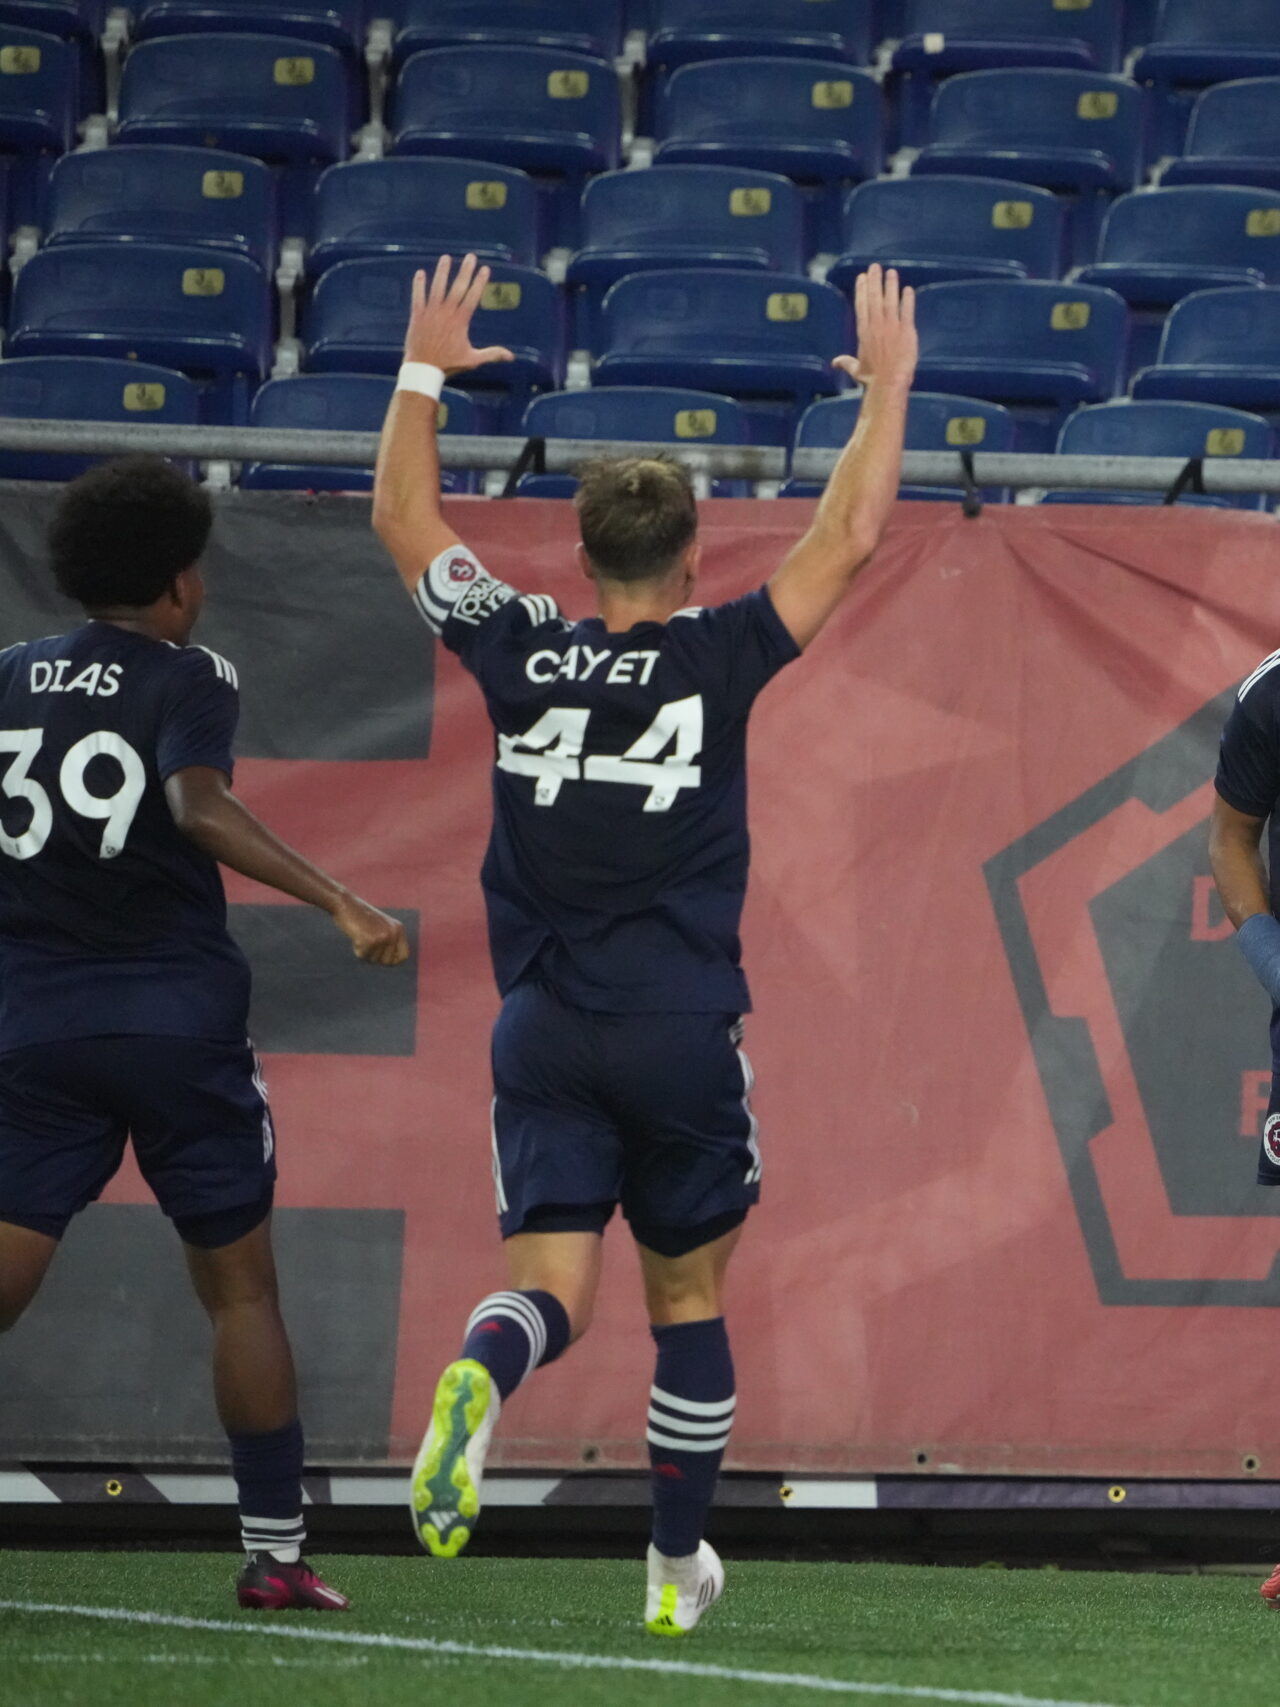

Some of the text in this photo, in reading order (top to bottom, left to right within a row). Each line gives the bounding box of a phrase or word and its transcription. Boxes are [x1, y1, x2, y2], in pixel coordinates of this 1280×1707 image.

[30, 659, 124, 696] DIAS
[525, 645, 661, 686] CAYET
[496, 693, 704, 813] 44
[0, 728, 146, 860] 39
